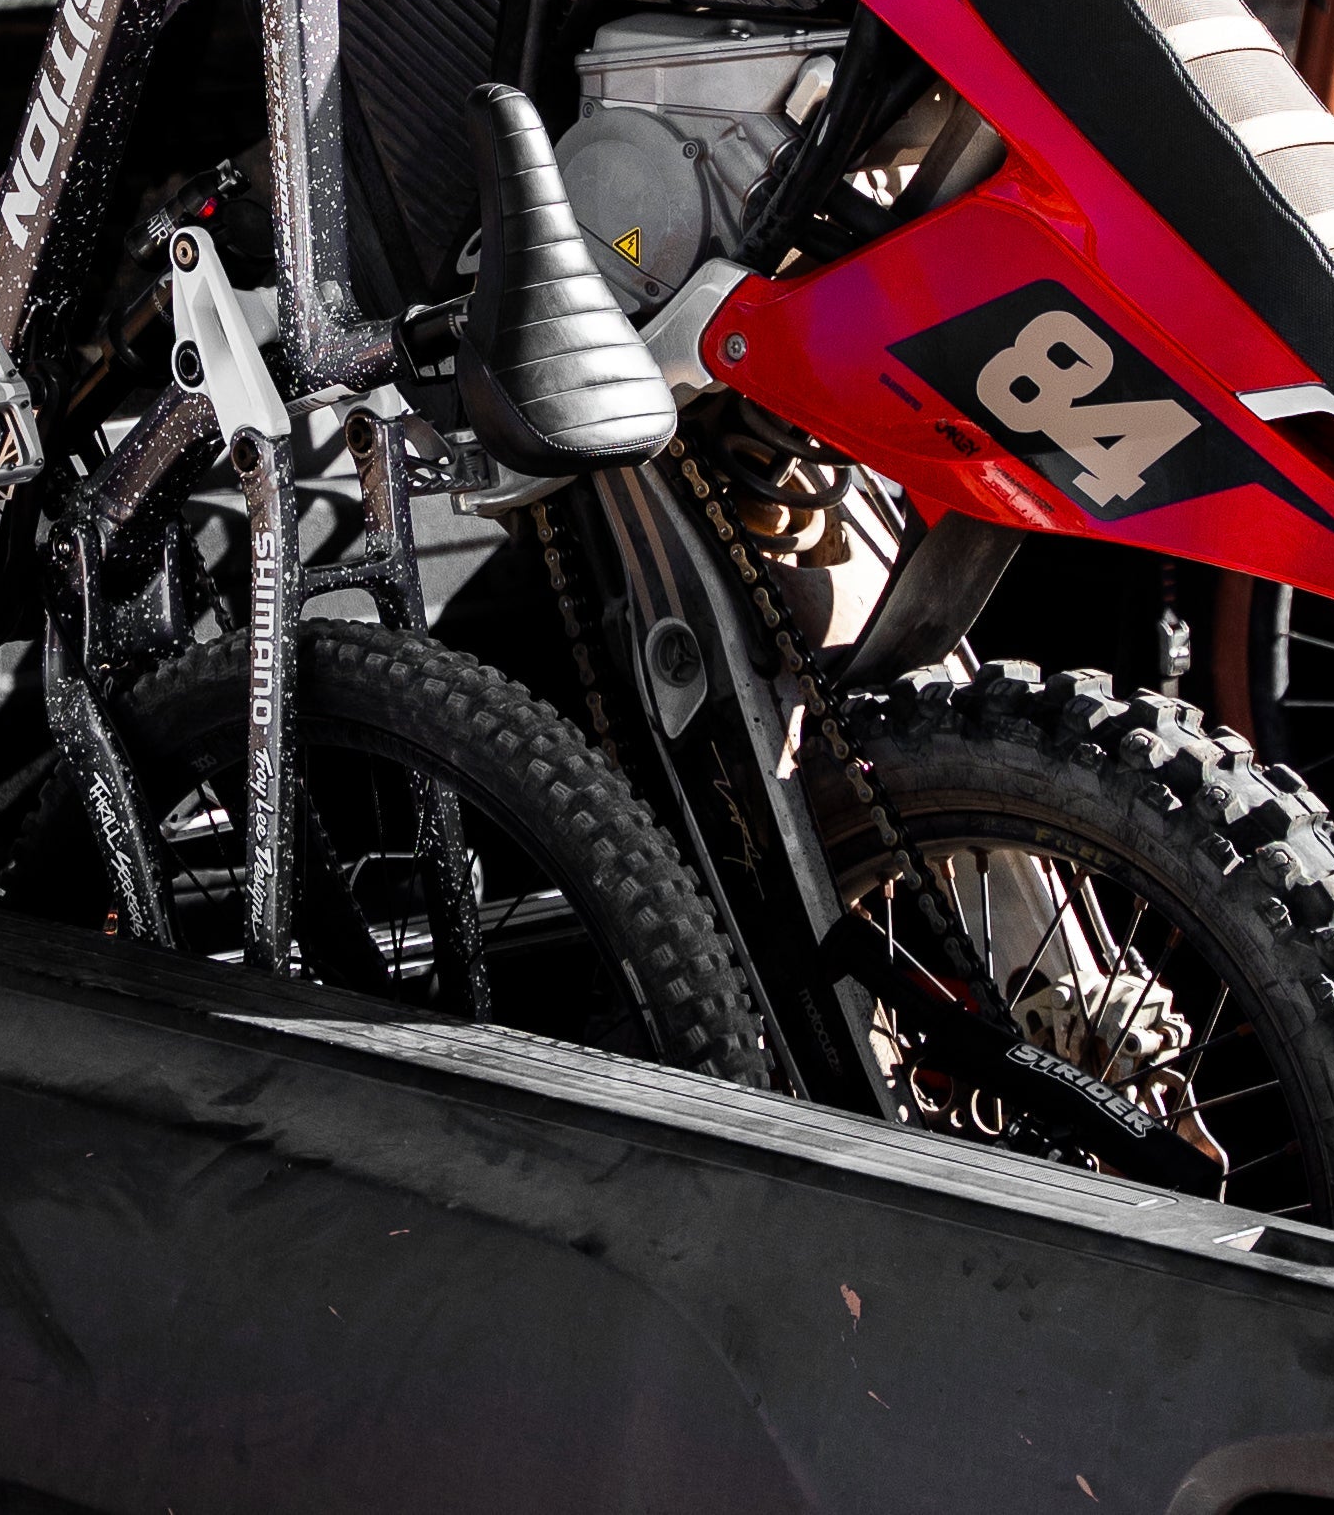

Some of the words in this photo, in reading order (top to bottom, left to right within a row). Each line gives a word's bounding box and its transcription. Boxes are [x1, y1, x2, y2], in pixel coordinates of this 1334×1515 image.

[147, 215, 170, 245] AIR
[934, 417, 982, 458] OAKLEY
[976, 310, 1203, 508] 84
[252, 530, 275, 726] SHIMANO
[249, 746, 274, 791] Troy
[88, 770, 117, 853] THRILL
[113, 850, 146, 939] SEEKERS
[254, 791, 276, 839] Lee
[245, 846, 274, 943] Designs
[798, 988, 841, 1072] motocutz
[1007, 1043, 1157, 1138] STRIDER
